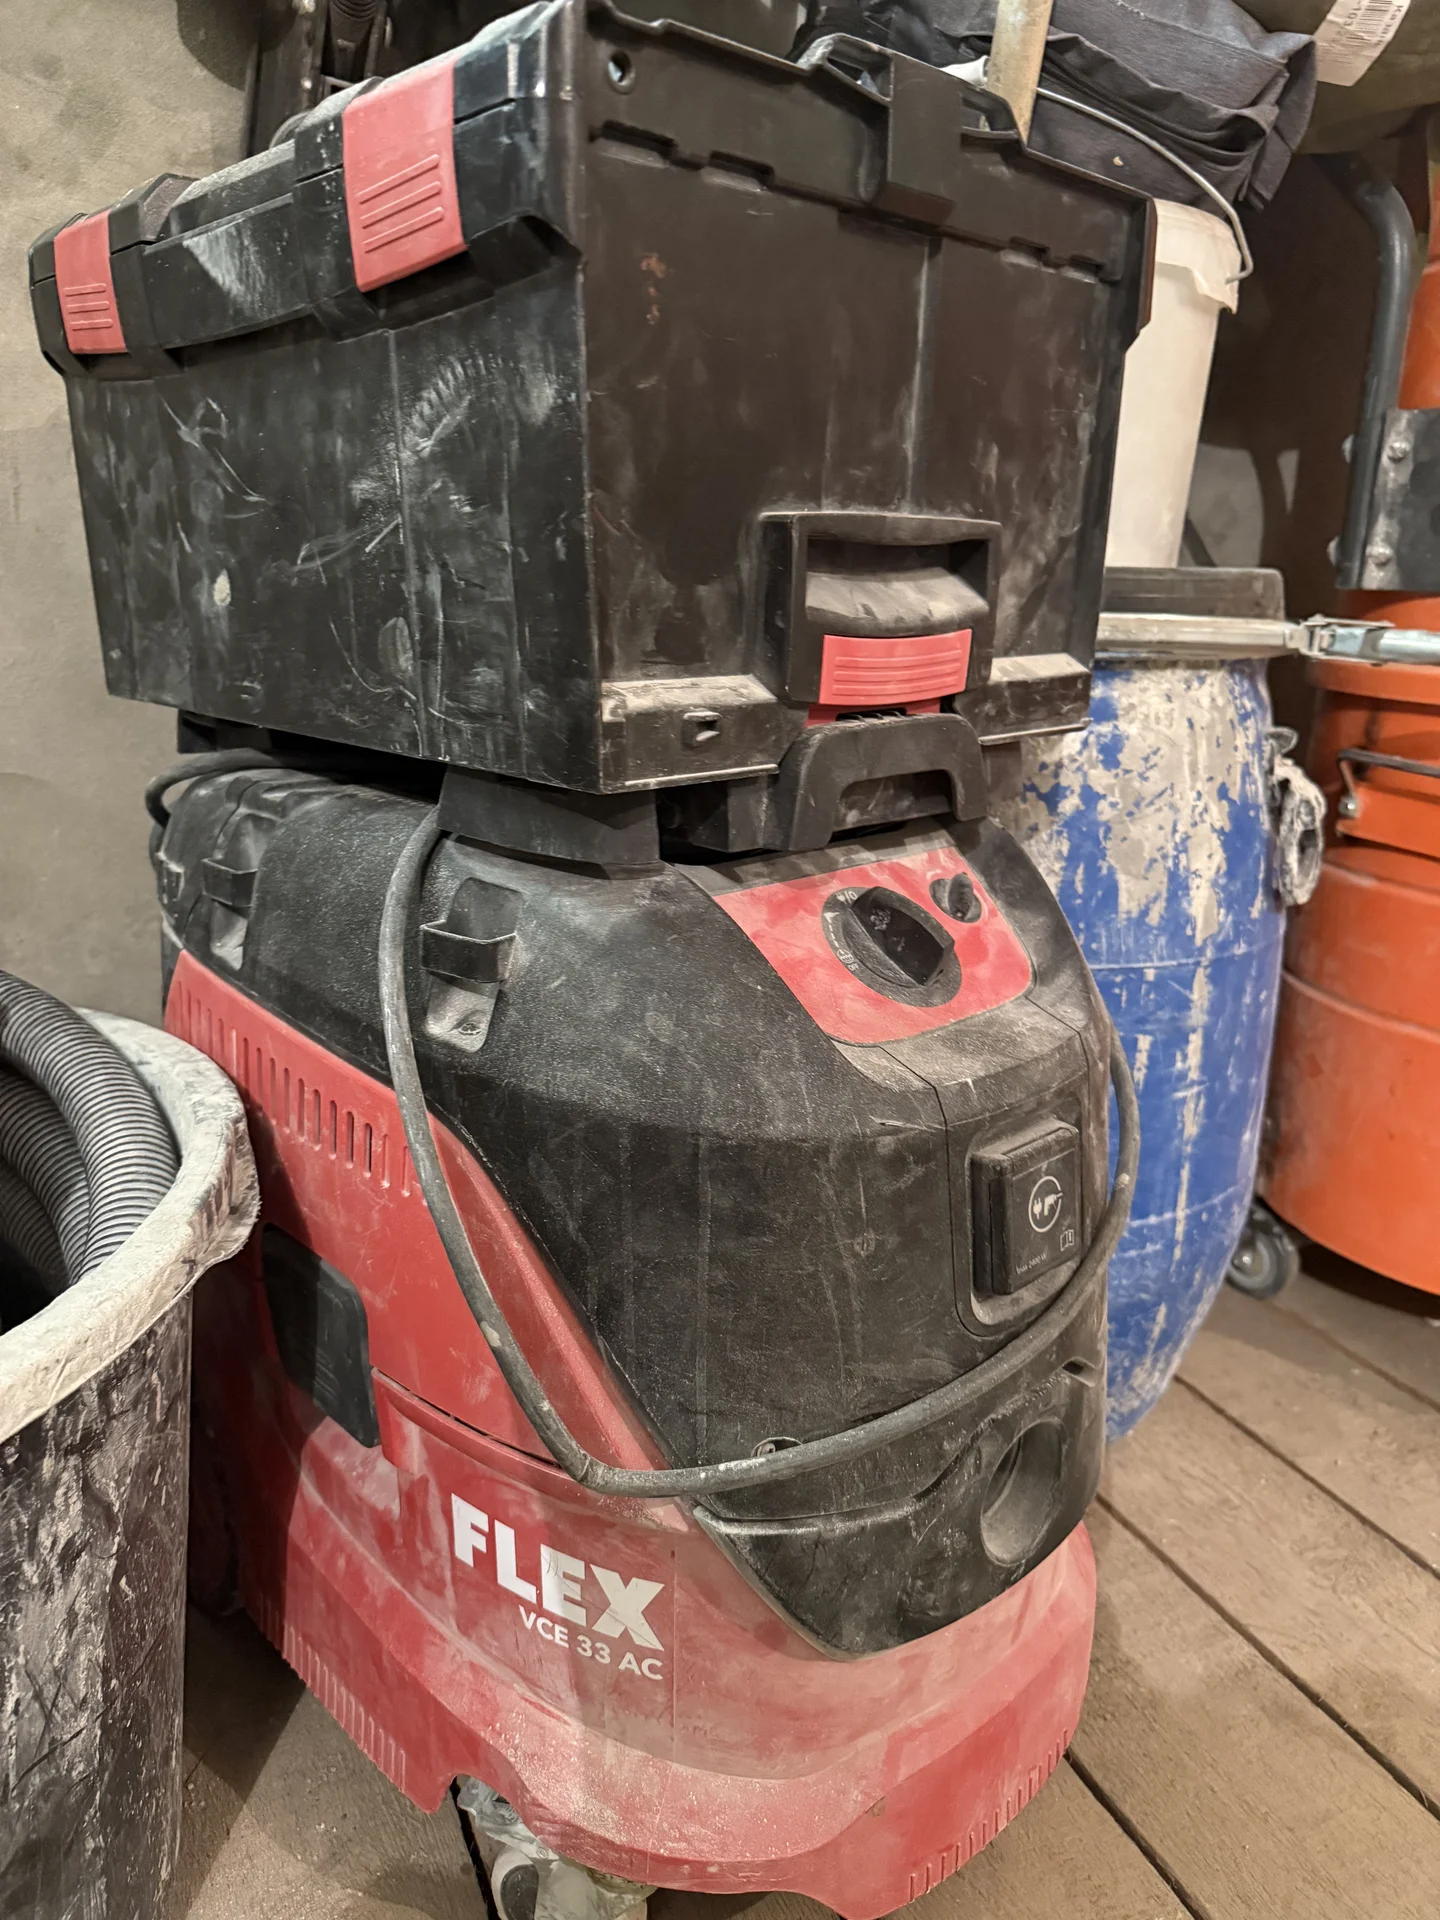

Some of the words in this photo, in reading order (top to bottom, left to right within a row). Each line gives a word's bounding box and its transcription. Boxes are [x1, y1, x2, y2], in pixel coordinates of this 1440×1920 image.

[451, 1493, 665, 1651] FLEX
[518, 1604, 569, 1648] VCE
[576, 1634, 611, 1664] 33
[618, 1651, 664, 1680] AC
